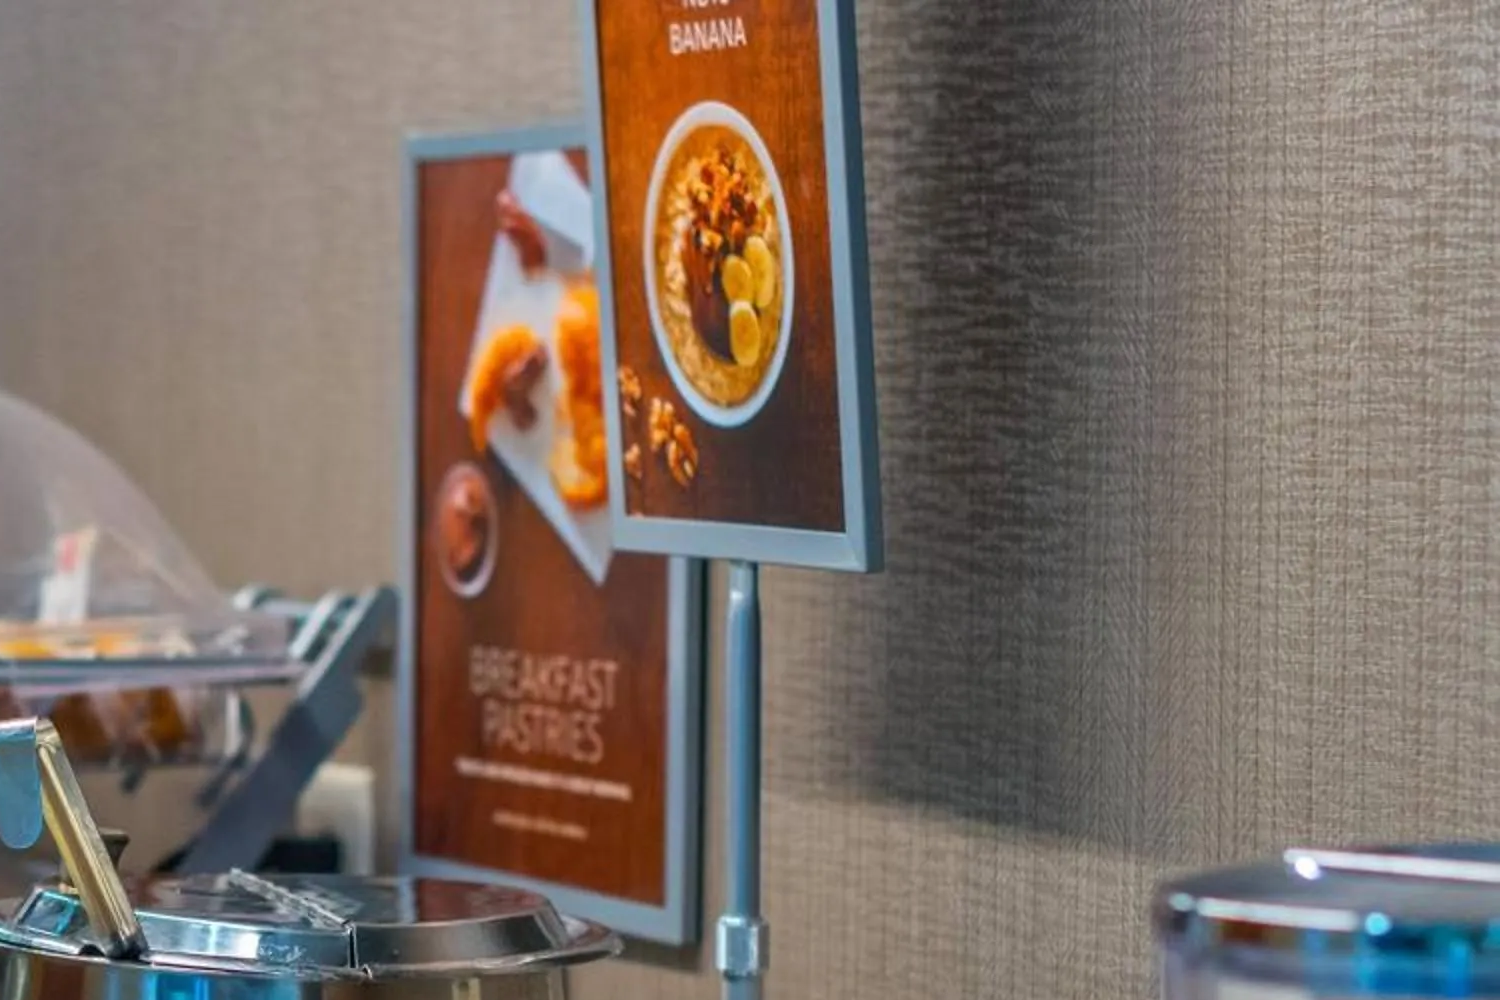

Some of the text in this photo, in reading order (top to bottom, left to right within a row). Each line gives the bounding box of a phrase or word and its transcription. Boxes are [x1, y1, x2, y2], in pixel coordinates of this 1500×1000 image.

[668, 16, 748, 55] BANANA
[469, 645, 618, 710] BREAKFAST
[484, 699, 603, 764] PASTRIES
